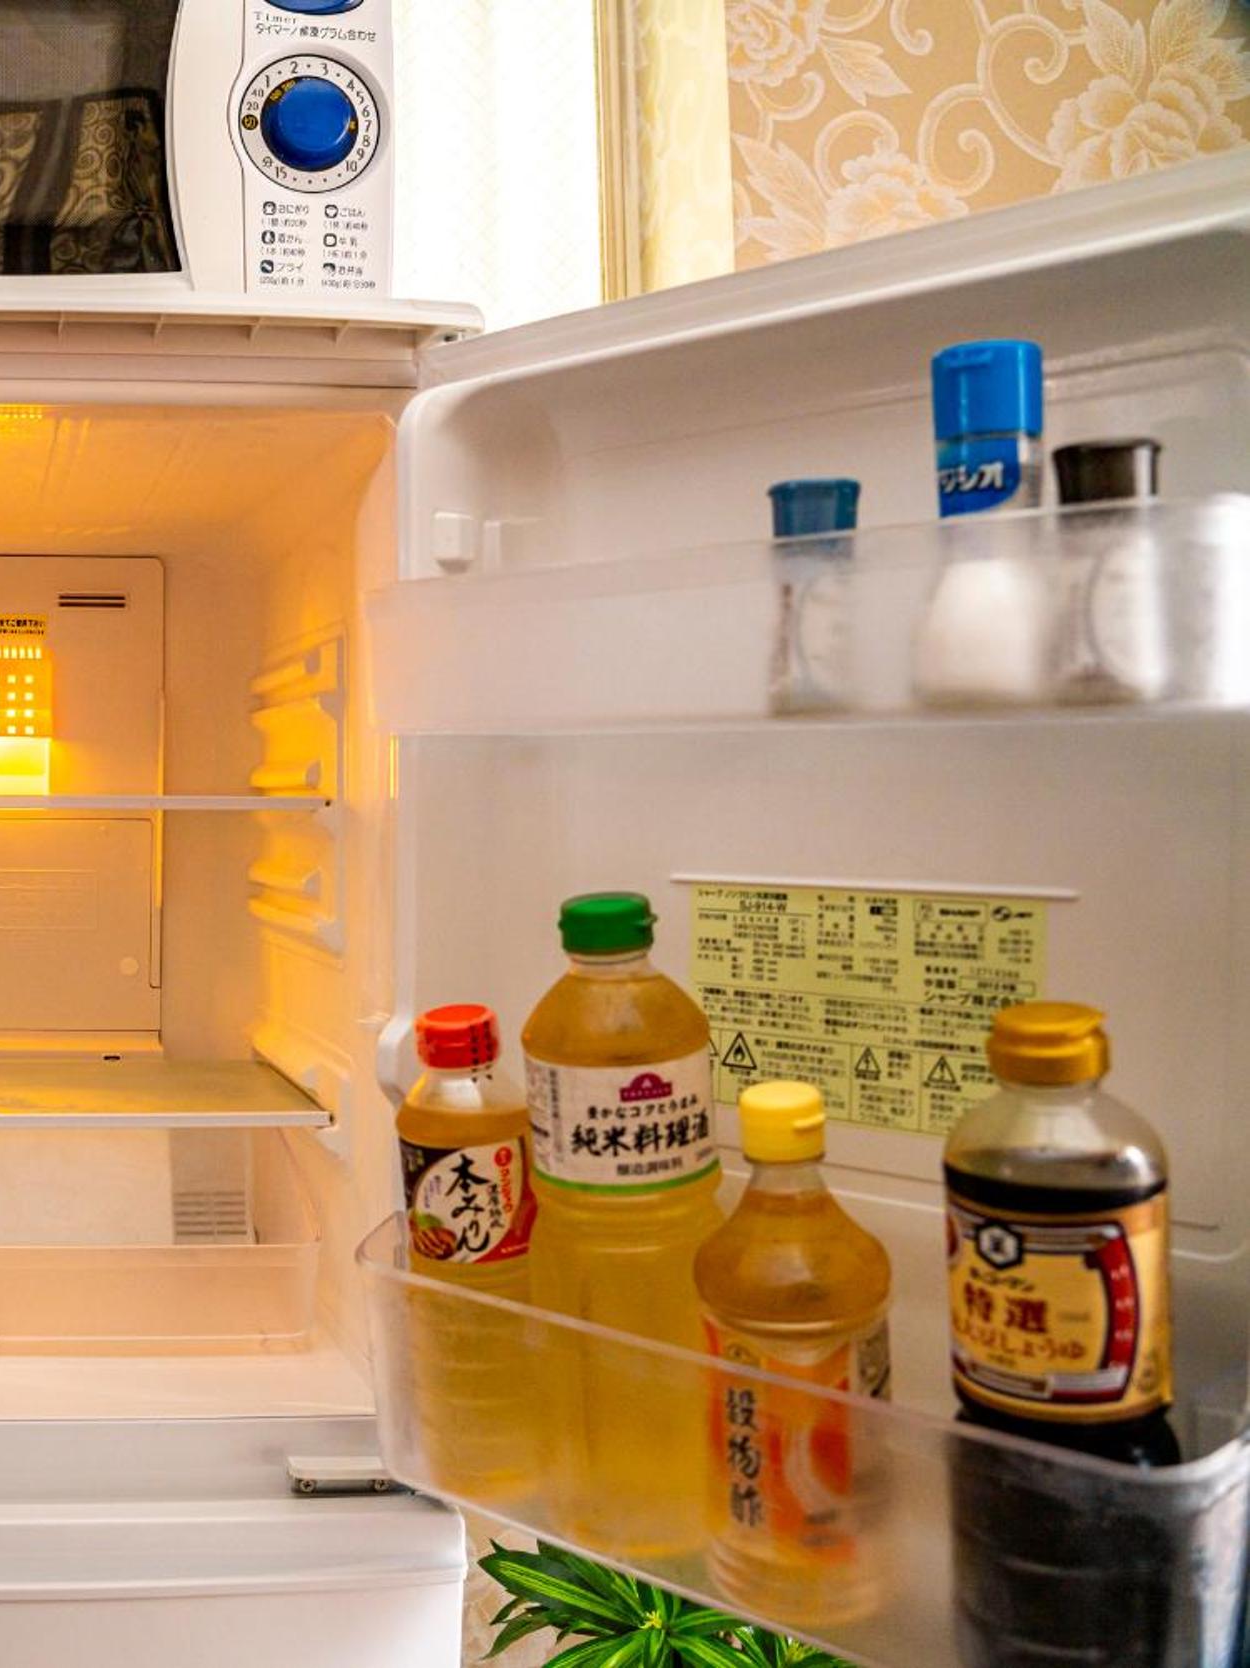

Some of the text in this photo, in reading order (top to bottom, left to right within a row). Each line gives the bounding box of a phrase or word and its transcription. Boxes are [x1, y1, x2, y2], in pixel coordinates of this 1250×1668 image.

[290, 61, 298, 74] 2
[320, 63, 329, 76] 3
[347, 79, 355, 92] 4
[356, 91, 365, 105] 5
[246, 102, 259, 111] 20
[362, 106, 370, 118] 6
[365, 120, 372, 132] 7
[362, 134, 371, 147] 8
[357, 148, 365, 161] 9
[275, 165, 288, 179] 15
[345, 160, 358, 172] 10
[278, 204, 310, 216] おにぎり
[339, 207, 366, 218] ごはん
[276, 262, 304, 274] フライ
[586, 1093, 698, 1120] 豊かなコクとうまみ
[571, 1108, 709, 1157] 純米料理酒
[445, 1153, 492, 1253] 本みりん
[963, 1282, 1048, 1335] 特選
[726, 1387, 763, 1528] 穀物酢
